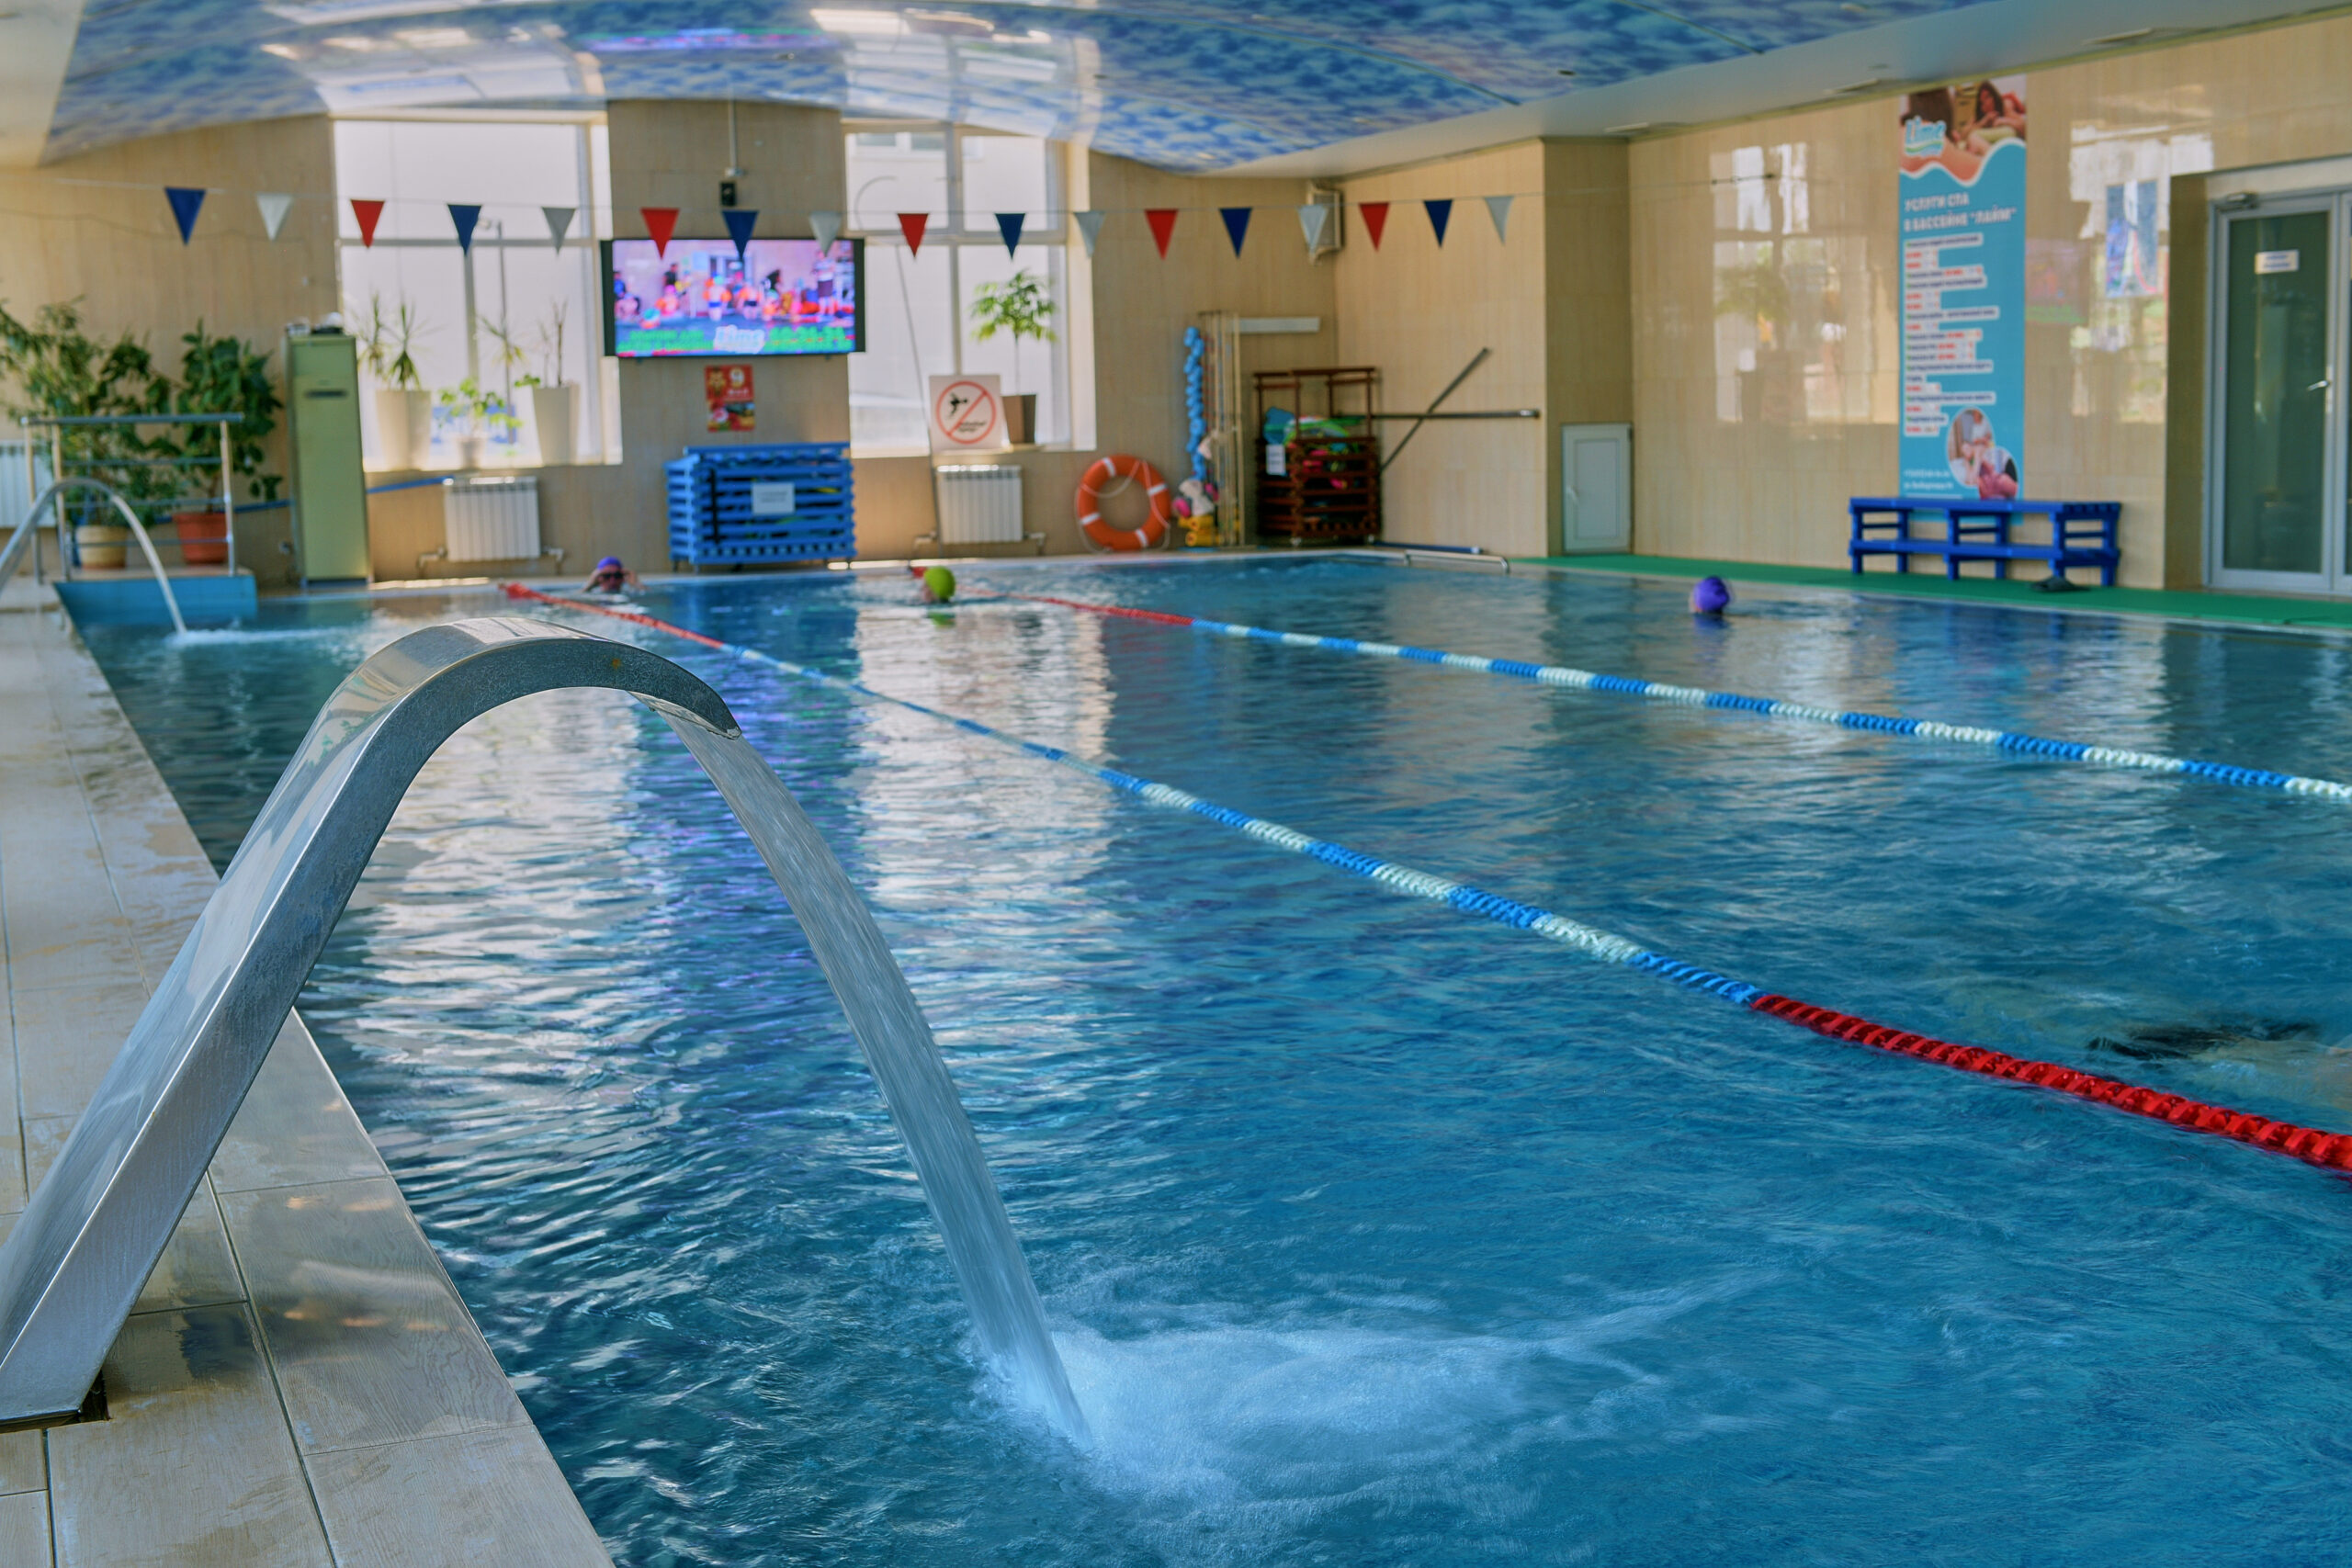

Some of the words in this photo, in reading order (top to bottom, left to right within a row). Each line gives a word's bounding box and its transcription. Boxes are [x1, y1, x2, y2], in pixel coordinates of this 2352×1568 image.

[1905, 195, 1945, 212] УСЛУГИ
[1947, 191, 1970, 207] СПА
[1912, 210, 1968, 231] БАССЕЙНЕ
